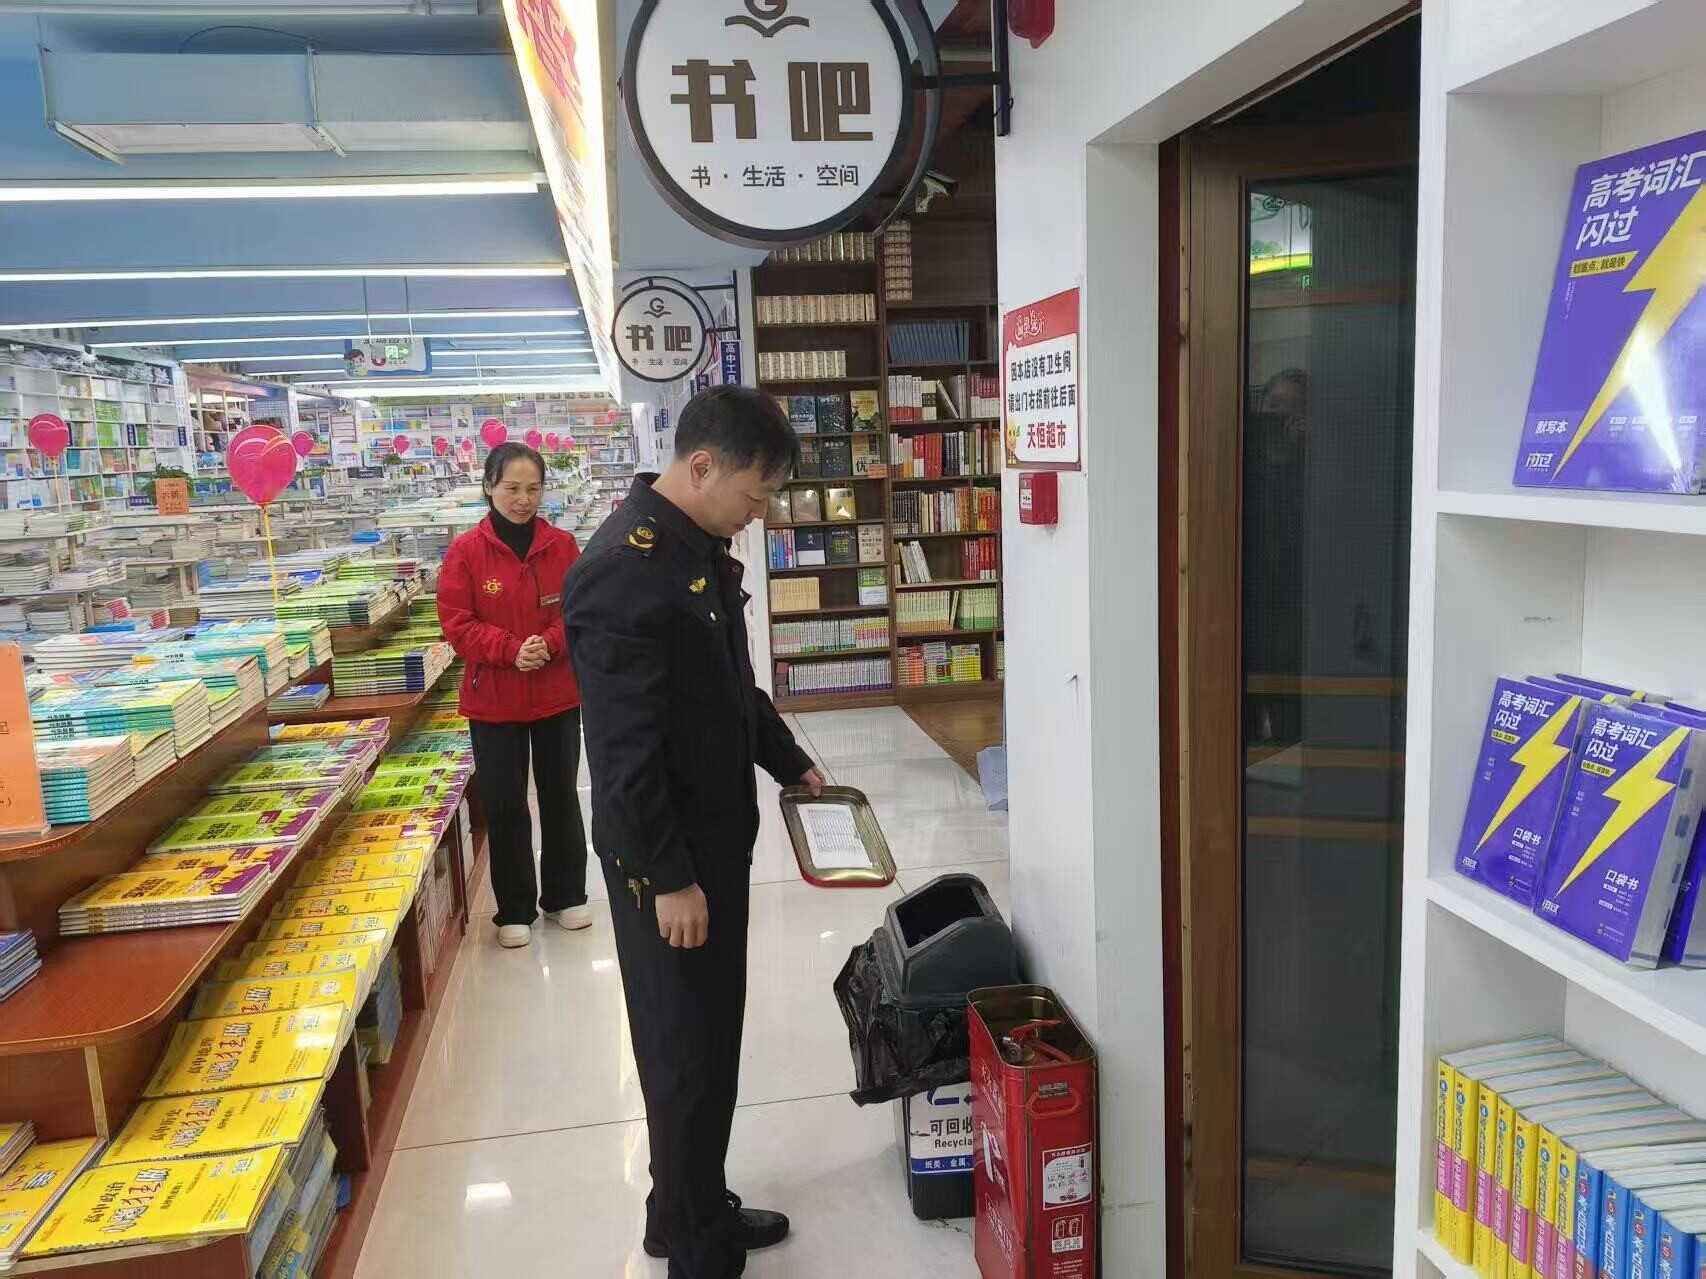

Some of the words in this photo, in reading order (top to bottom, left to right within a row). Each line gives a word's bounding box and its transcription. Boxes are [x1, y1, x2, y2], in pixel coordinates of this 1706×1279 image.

[670, 59, 874, 142] 书吧
[1583, 150, 1706, 212] 高考词汇
[1576, 206, 1639, 250] 闪过
[626, 325, 692, 351] 书吧
[725, 344, 737, 385] 高中工具
[1010, 351, 1071, 382] 因本店没有卫生间
[1008, 384, 1076, 413] 请出门右拐前往后面
[1027, 420, 1067, 449] 天恒超市
[1535, 420, 1568, 434] 默写本
[1498, 690, 1554, 718] 高考词汇
[1494, 709, 1522, 730] 闪过
[1590, 718, 1657, 749] 高考词汇
[1585, 738, 1619, 762] 闪过
[1514, 827, 1541, 845] 口袋书
[1605, 869, 1639, 890] 口袋书
[84, 1181, 126, 1224] 高中政治
